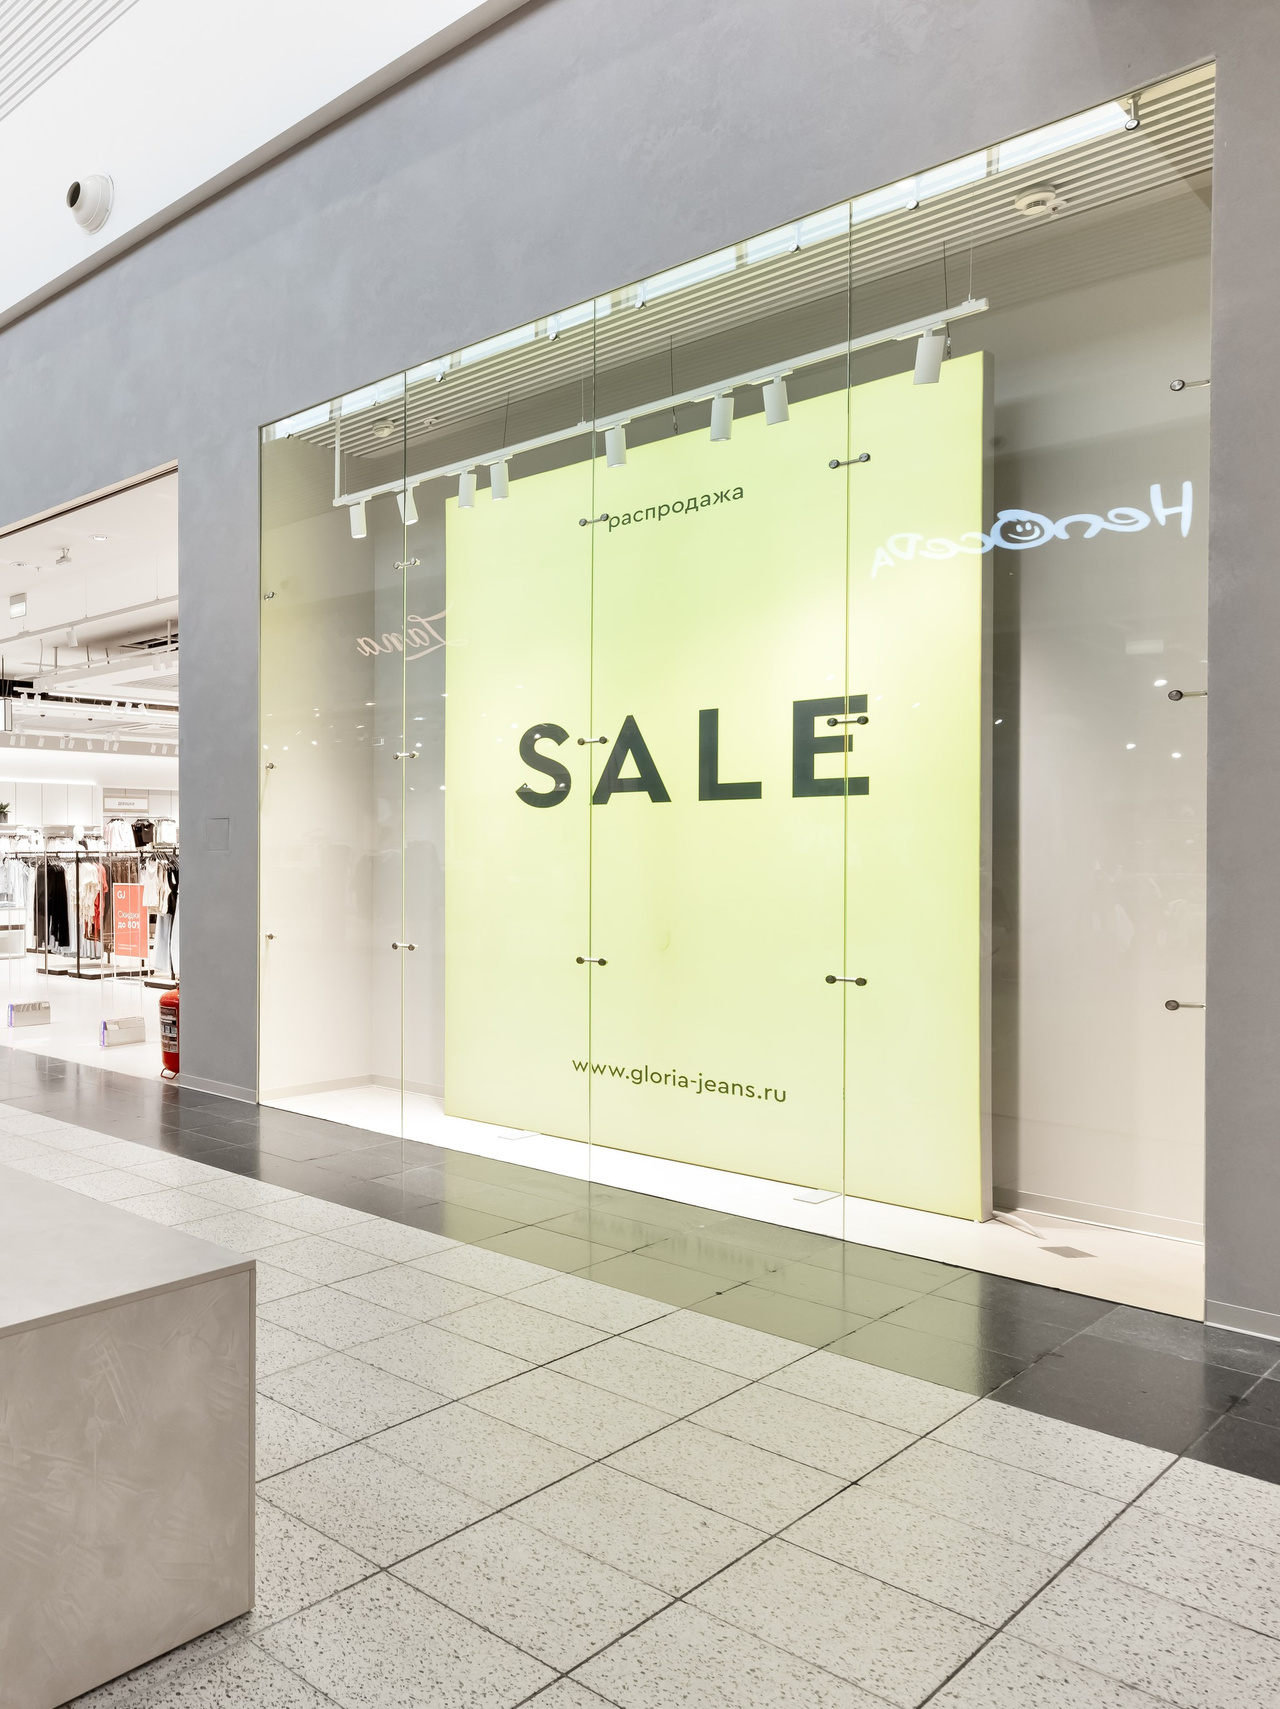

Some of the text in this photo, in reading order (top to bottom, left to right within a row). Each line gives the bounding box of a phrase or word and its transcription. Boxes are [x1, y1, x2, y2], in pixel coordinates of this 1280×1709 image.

[608, 486, 744, 532] распродажа
[515, 694, 869, 808] SALE
[572, 1059, 787, 1103] www.gloria-jeans.ru
